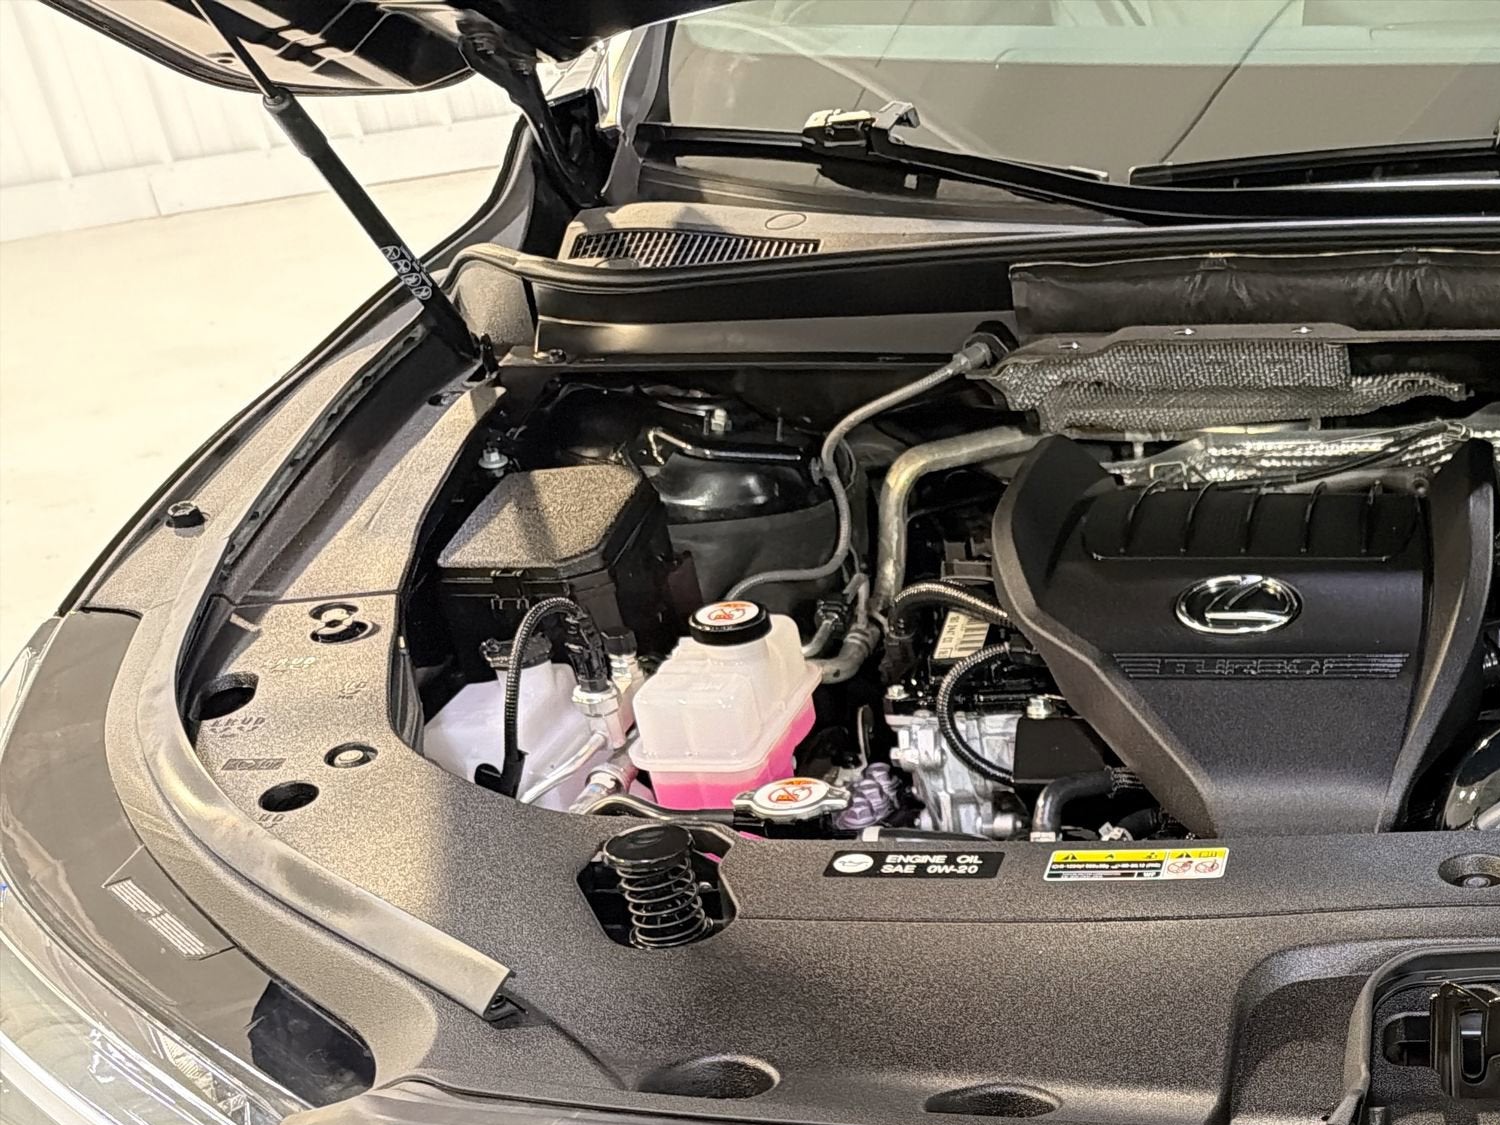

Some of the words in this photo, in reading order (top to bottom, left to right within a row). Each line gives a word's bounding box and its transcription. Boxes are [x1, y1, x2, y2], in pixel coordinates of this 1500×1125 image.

[885, 854, 948, 864] ENGINE
[956, 854, 983, 864] OIL
[880, 864, 917, 874] SAE
[926, 864, 979, 874] 0W-20
